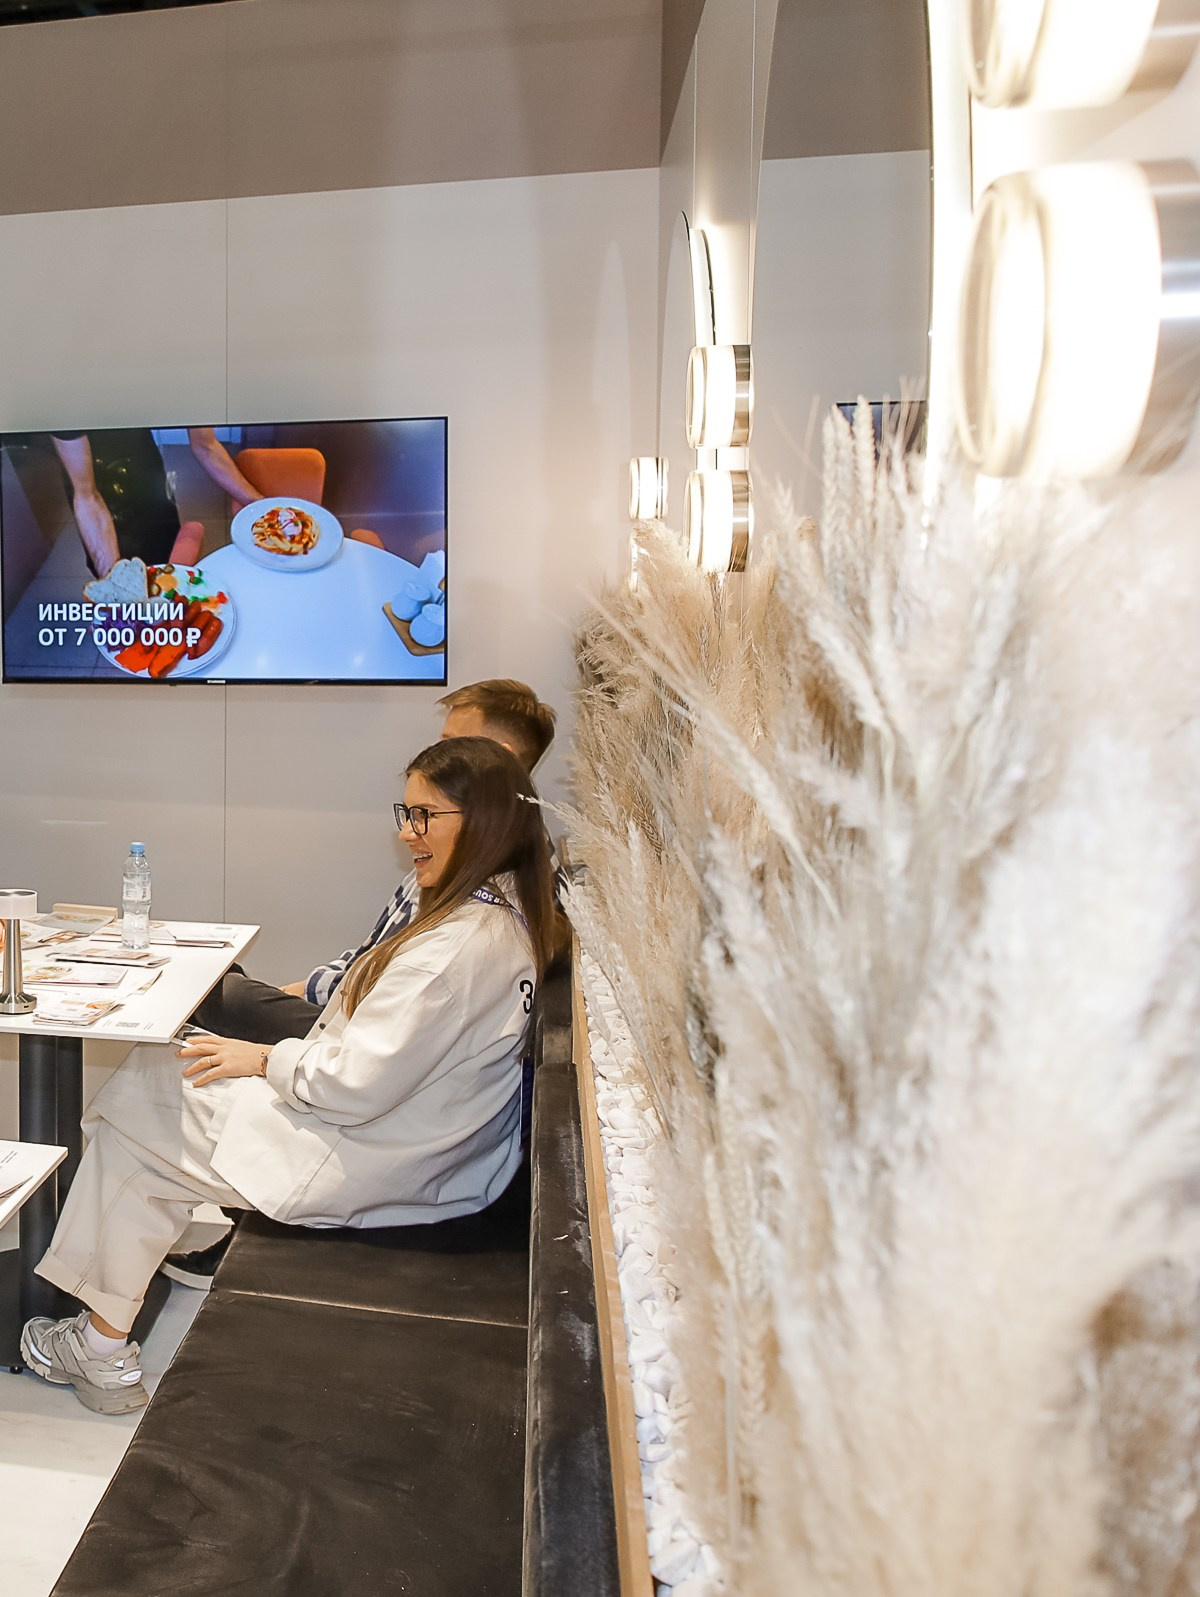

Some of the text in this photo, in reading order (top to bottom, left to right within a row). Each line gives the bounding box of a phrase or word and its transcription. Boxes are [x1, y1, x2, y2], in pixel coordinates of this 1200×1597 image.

[37, 602, 184, 624] ИНВЕСТИЦИИ
[38, 628, 67, 647] ОТ
[74, 628, 86, 646] 7
[93, 627, 135, 646] 000
